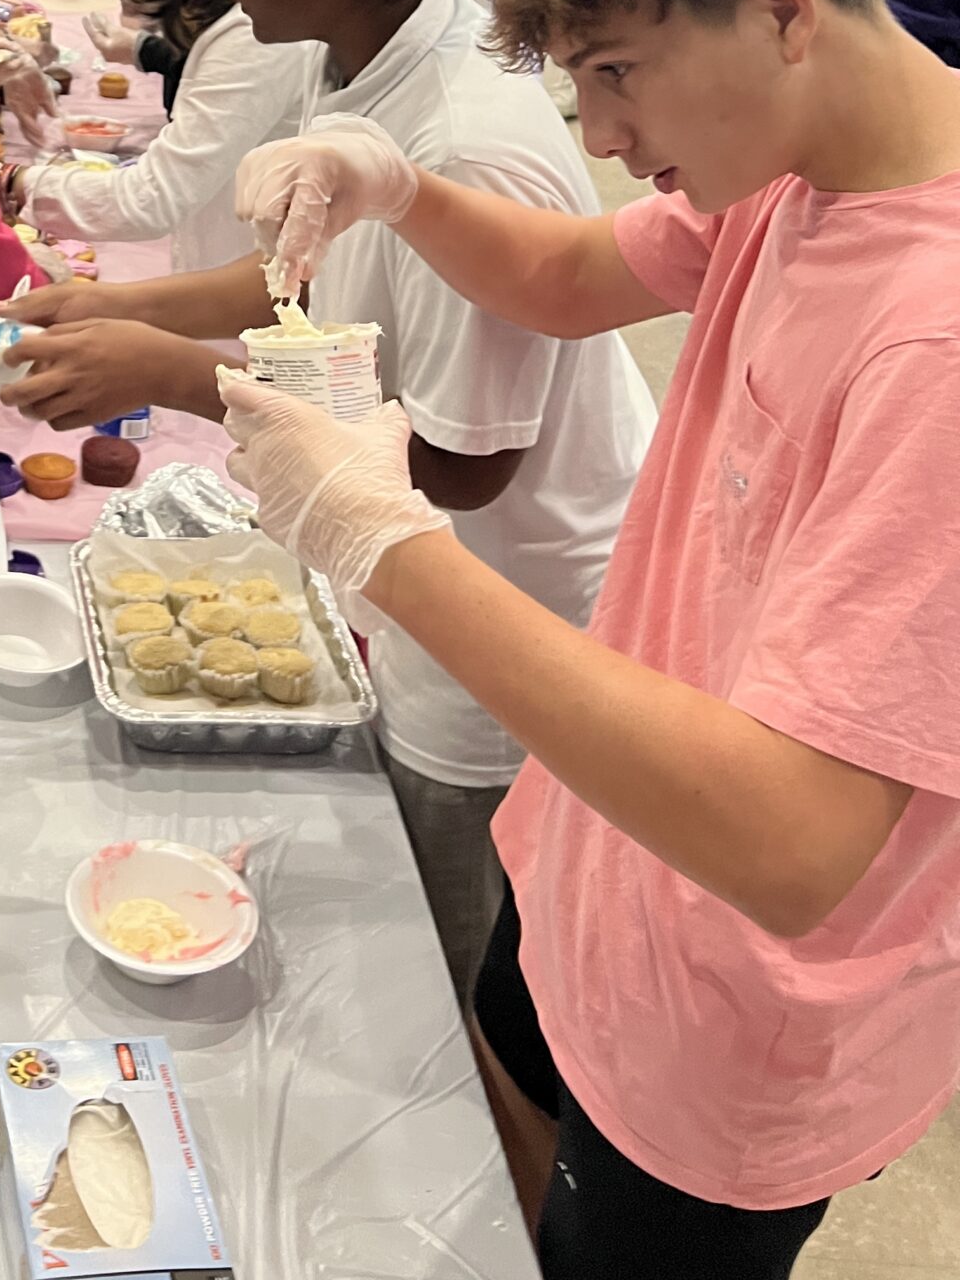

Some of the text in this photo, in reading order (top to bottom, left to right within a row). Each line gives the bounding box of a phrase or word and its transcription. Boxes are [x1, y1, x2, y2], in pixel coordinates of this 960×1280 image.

[7, 1050, 33, 1084] LATEX
[187, 1170, 203, 1194] FREE
[194, 1196, 216, 1242] POWDER
